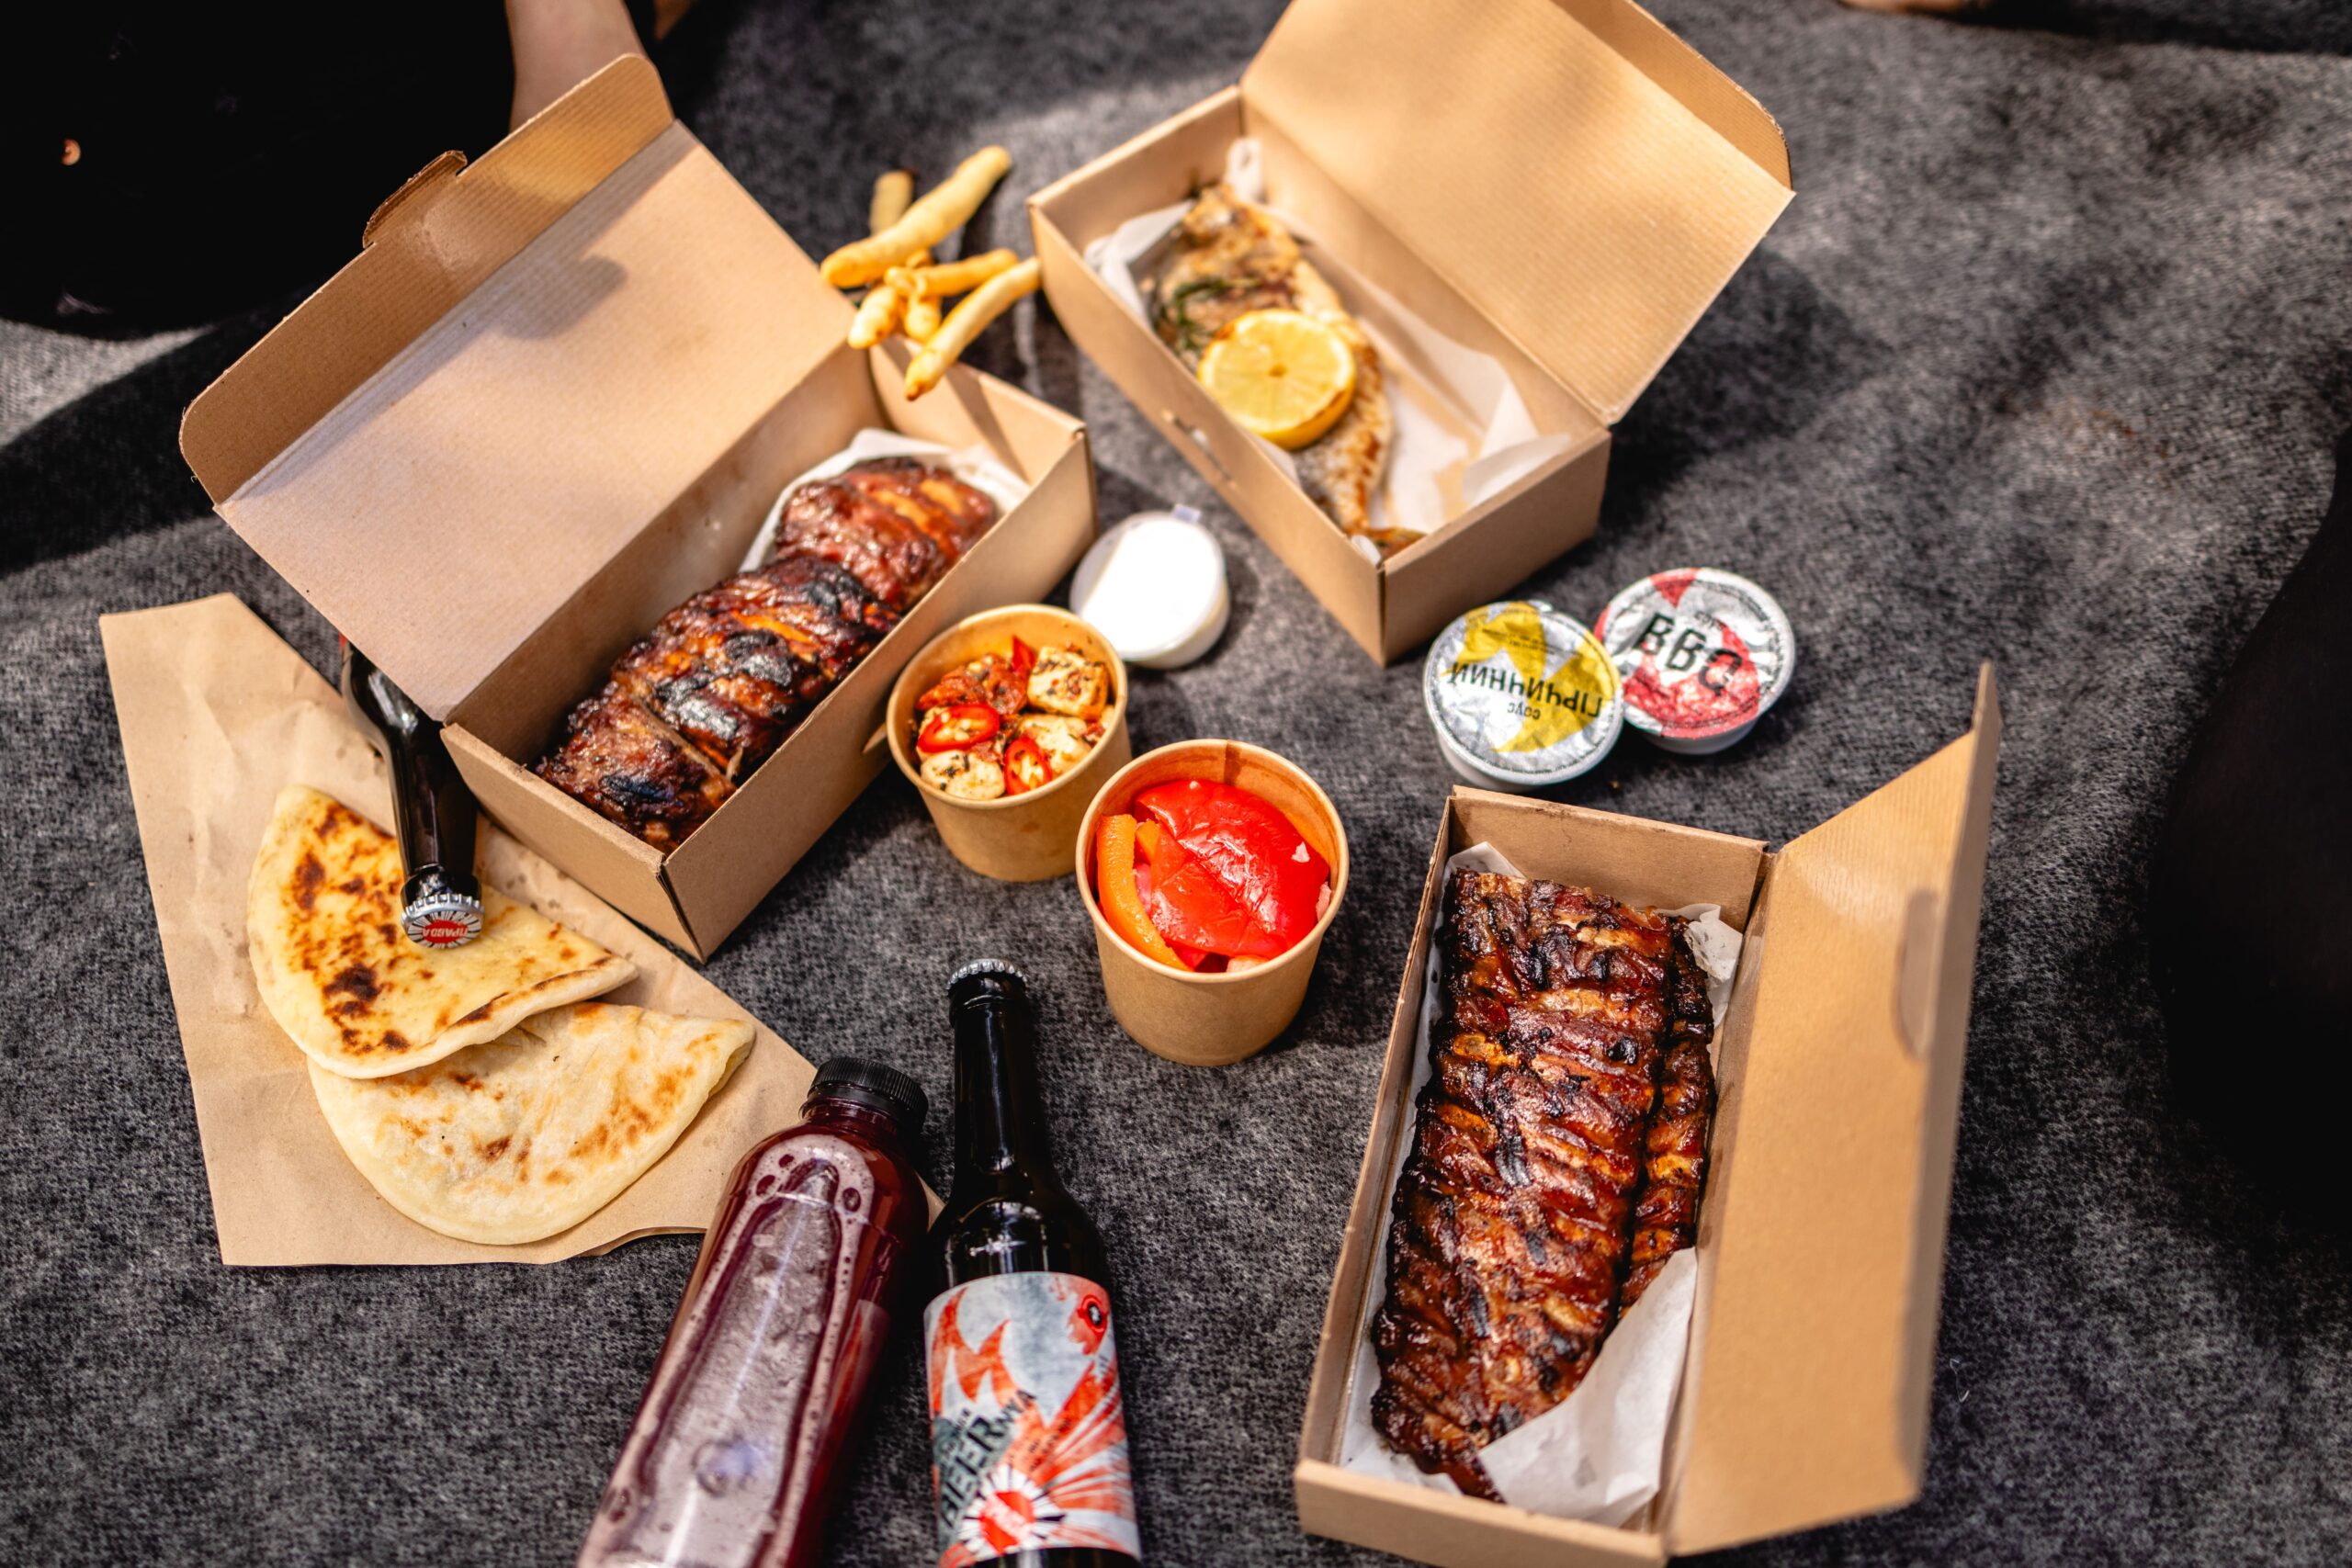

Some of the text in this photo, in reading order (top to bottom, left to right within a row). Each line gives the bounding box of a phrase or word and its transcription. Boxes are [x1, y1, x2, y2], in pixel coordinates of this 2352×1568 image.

[1633, 613, 1743, 696] BBQ
[1448, 661, 1602, 718] ГІРЧИЧНИЙ
[1507, 702, 1541, 720] соус
